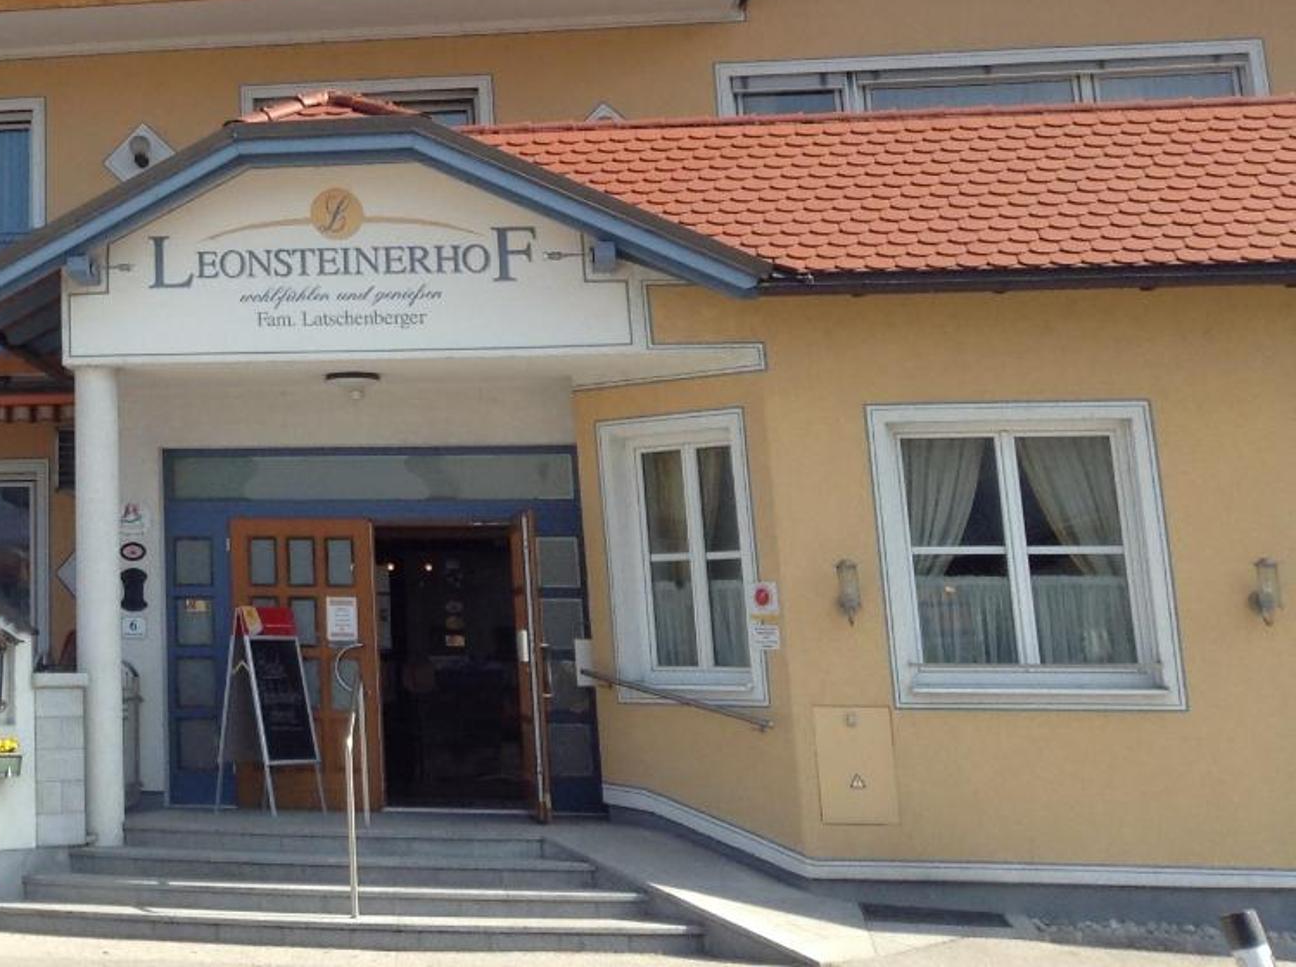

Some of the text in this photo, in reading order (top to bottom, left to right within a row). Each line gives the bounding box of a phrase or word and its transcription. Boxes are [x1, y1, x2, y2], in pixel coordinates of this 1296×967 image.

[149, 226, 537, 289] LEONSTEINERHOF
[240, 286, 329, 310] wohlfühlen
[336, 285, 375, 302] und
[257, 309, 429, 329] Fam. Latschenberger
